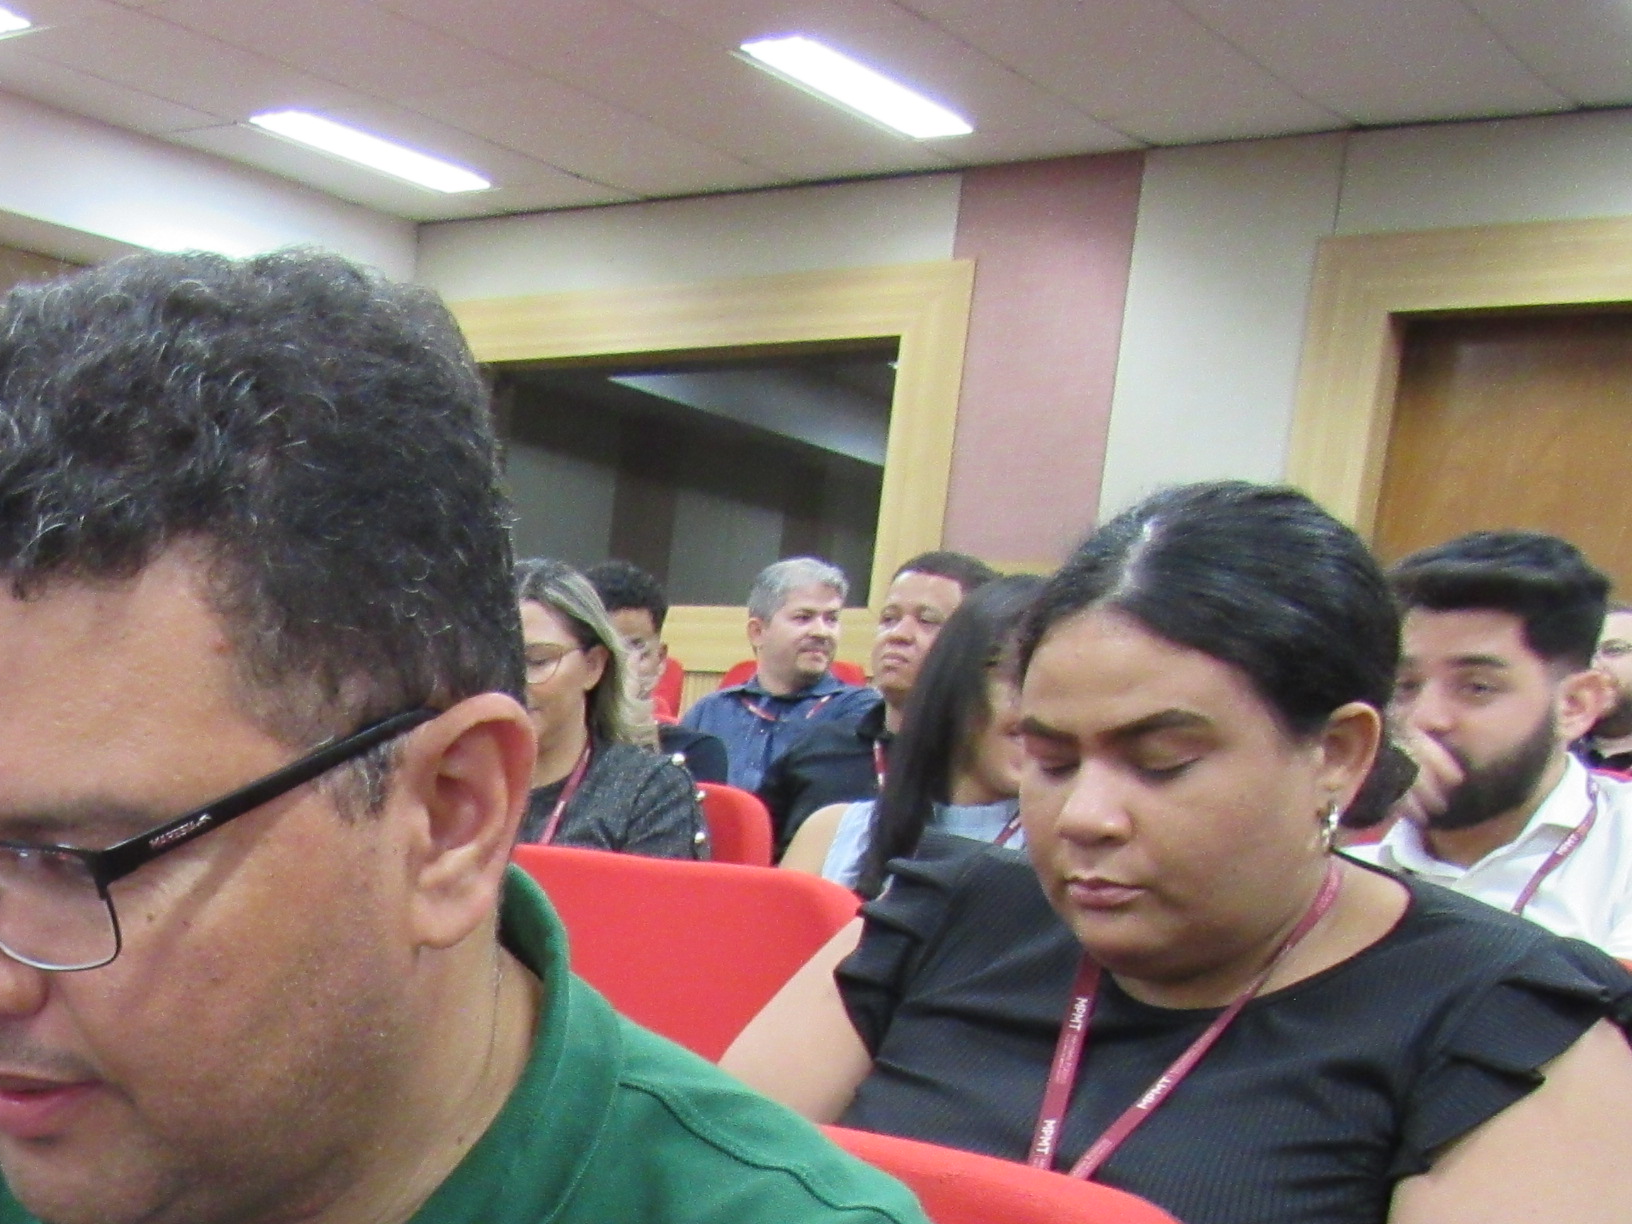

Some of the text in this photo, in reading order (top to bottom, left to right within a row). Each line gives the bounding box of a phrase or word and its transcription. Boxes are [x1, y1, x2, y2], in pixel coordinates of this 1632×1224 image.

[1068, 997, 1089, 1031] MPMT
[1136, 1076, 1172, 1110] MPMT
[1035, 1119, 1057, 1155] MPMT
